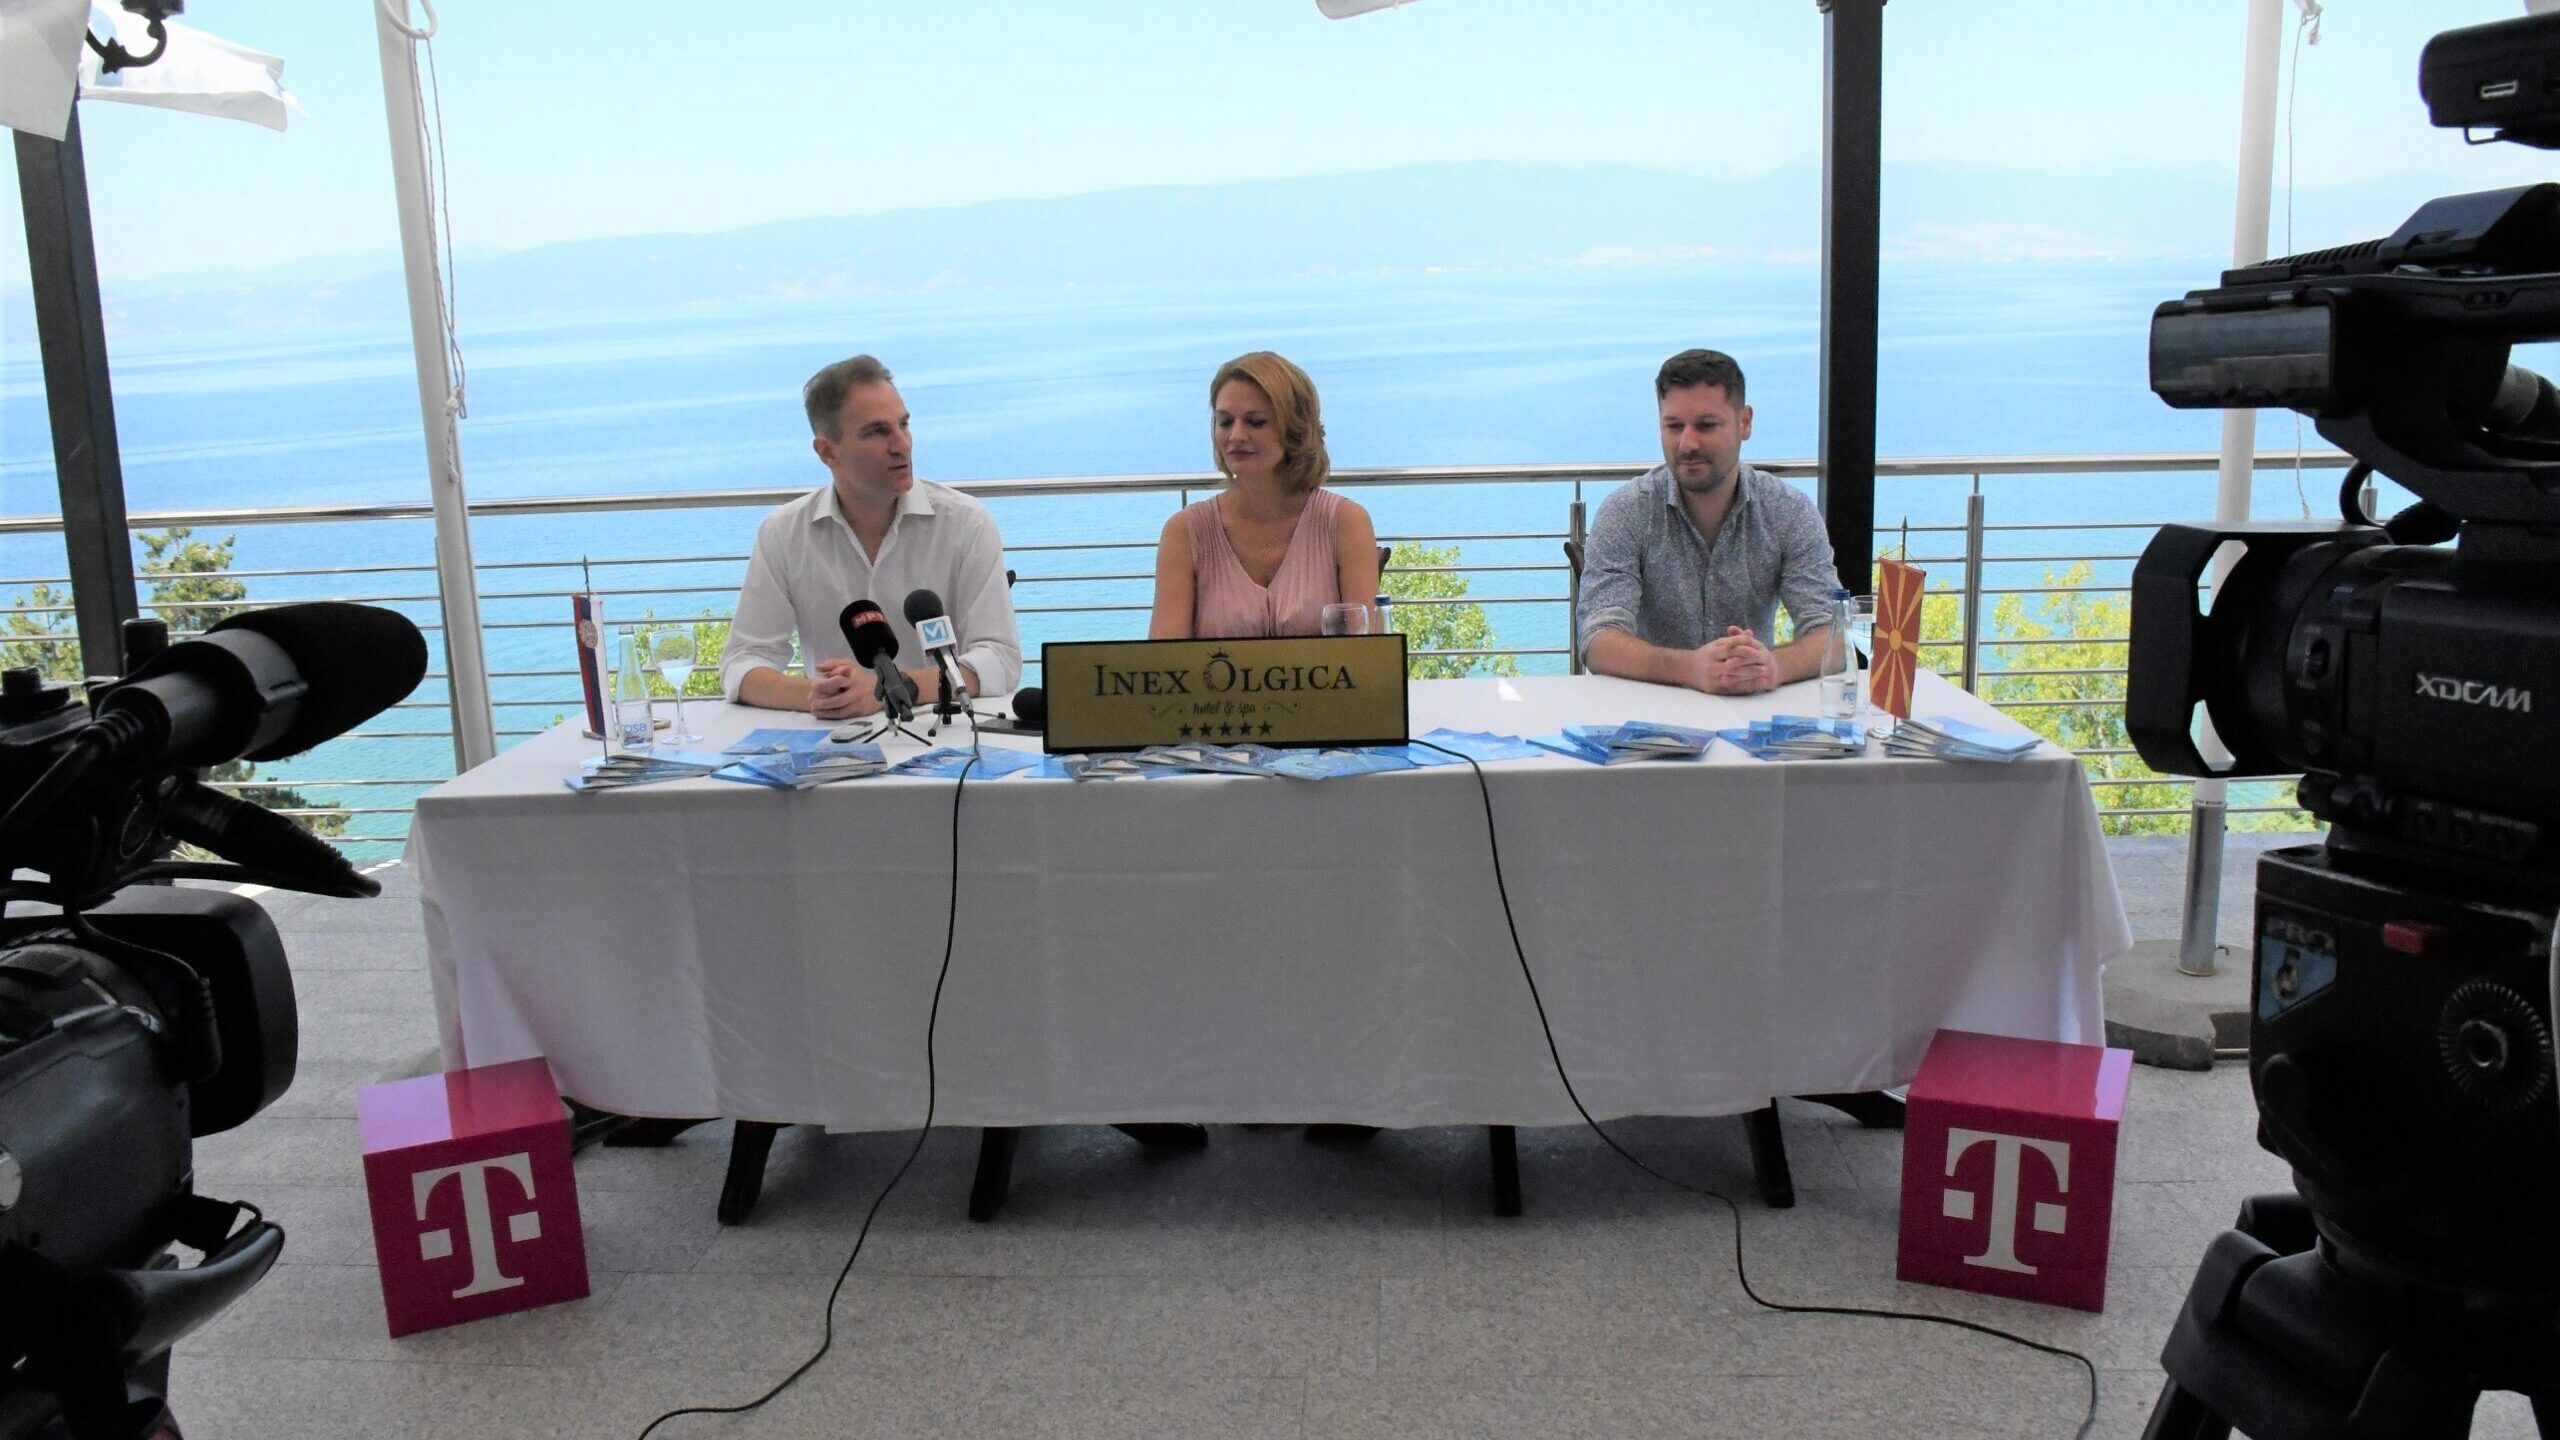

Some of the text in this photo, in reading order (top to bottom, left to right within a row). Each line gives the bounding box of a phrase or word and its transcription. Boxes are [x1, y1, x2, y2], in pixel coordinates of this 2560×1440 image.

[1203, 658, 1357, 693] OLGICA
[2415, 672, 2531, 713] XDCAM
[1193, 701, 1222, 715] hotel
[1238, 703, 1257, 718] spa
[1943, 1127, 2071, 1275] T
[411, 1152, 541, 1299] T
